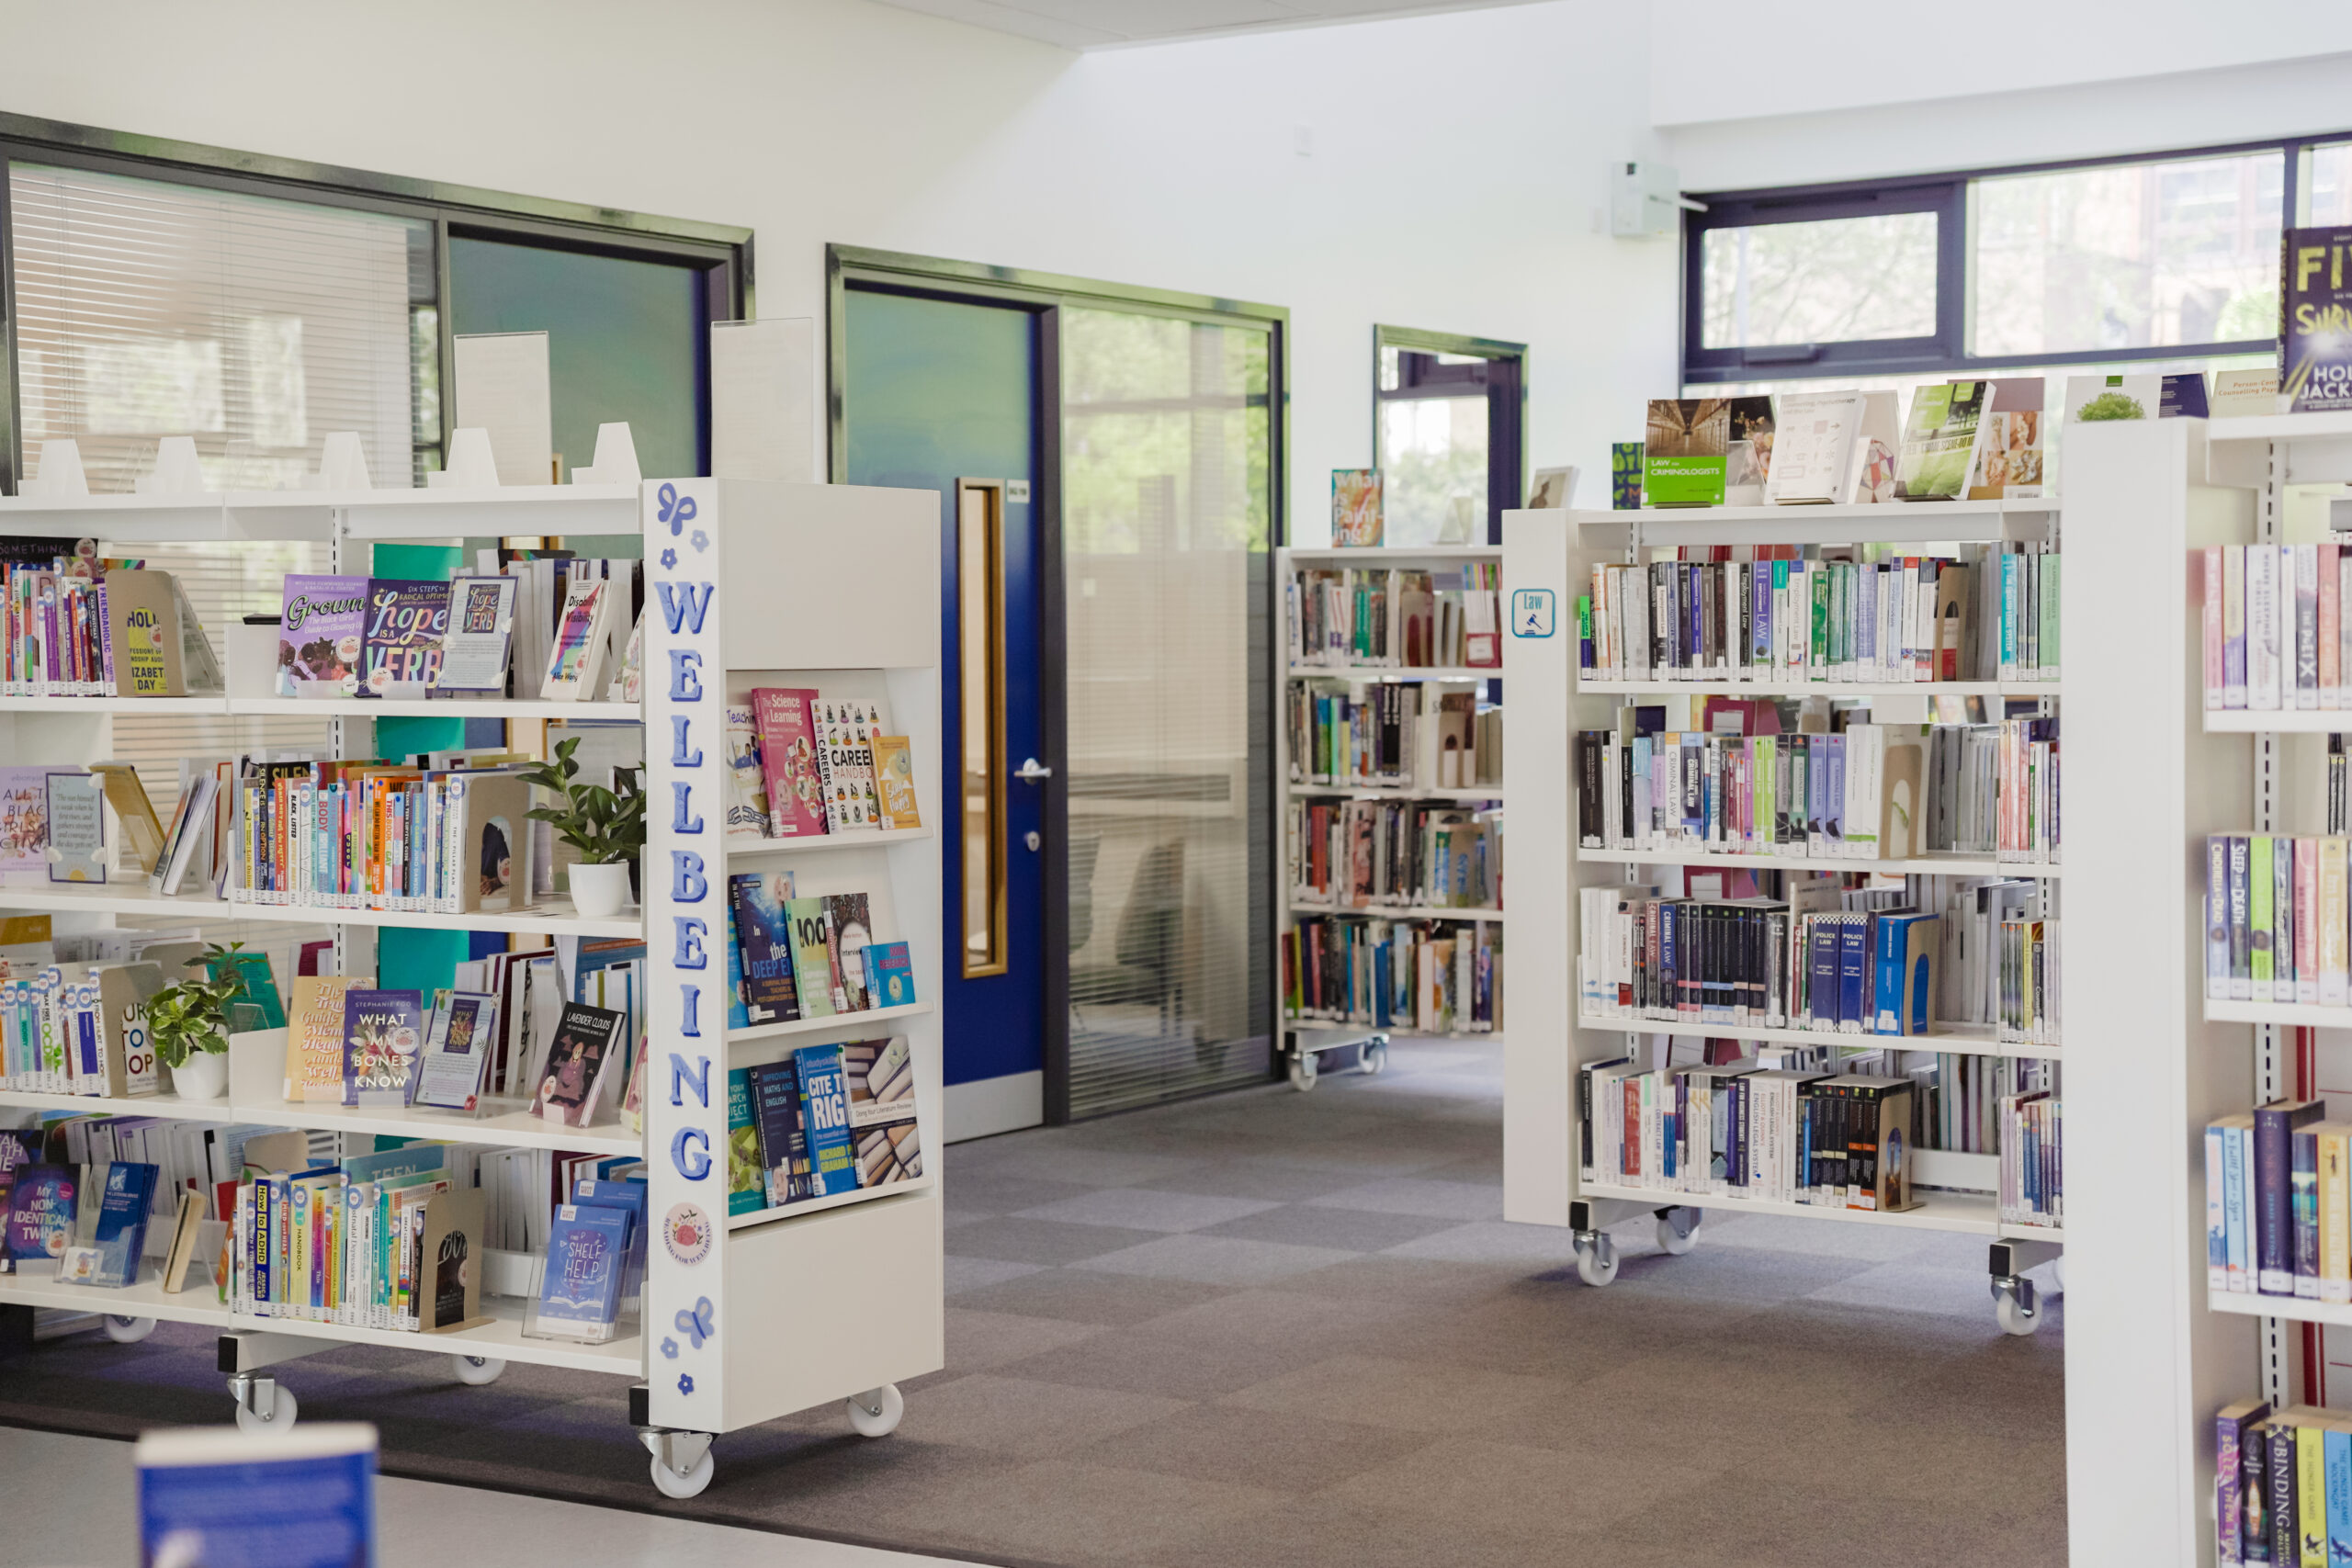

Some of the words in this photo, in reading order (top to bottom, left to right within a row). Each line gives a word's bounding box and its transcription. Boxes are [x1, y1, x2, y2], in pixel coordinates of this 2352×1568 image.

[1333, 471, 1381, 489] What
[1334, 507, 1384, 524] Paint-
[1334, 525, 1373, 545] ing?
[468, 587, 498, 609] hope
[569, 595, 598, 607] Disability
[1523, 593, 1543, 610] Law
[99, 587, 111, 653] FRIENDAHOLIC
[288, 594, 366, 631] Grown
[309, 616, 321, 626] The
[322, 615, 337, 624] Black
[368, 591, 447, 646] hope
[2302, 611, 2312, 626] THE
[304, 625, 322, 634] Guide
[466, 612, 494, 631] VERB
[1757, 614, 1767, 639] LAW
[367, 646, 443, 688] VERB
[2299, 661, 2316, 678] X
[138, 680, 155, 690] DAY
[772, 694, 800, 708] Science
[770, 710, 803, 725] Learning
[818, 739, 831, 786] CAREERS
[258, 768, 266, 799] SILENCE
[4, 789, 30, 800] ALL
[319, 801, 327, 832] BODY
[258, 832, 266, 861] OPTION
[319, 833, 327, 874] BRILLIANT
[2231, 844, 2246, 874] SLEEP
[2211, 844, 2223, 892] CINDERELLA
[653, 581, 716, 1181] WELLBEING
[2212, 898, 2224, 923] DEAD
[2233, 888, 2245, 924] DEATH
[1815, 931, 1836, 940] POLICE
[770, 944, 787, 961] the
[752, 960, 779, 979] DEEP
[359, 1014, 407, 1025] WHAT
[566, 1012, 592, 1027] LAVENDER
[592, 1019, 612, 1030] CLOUDS
[41, 1023, 51, 1055] OCD
[370, 1035, 390, 1045] MY
[354, 1055, 408, 1066] BONES
[355, 1077, 407, 1088] KNOW
[763, 1070, 792, 1083] IMPROVING
[729, 1083, 745, 1093] YOUR
[763, 1083, 781, 1095] MATHS
[782, 1082, 794, 1091] AND
[808, 1076, 832, 1096] CITE
[765, 1096, 787, 1108] ENGLISH
[855, 1110, 866, 1119] Doing
[867, 1109, 876, 1117] Your
[876, 1106, 896, 1115] Literature
[897, 1102, 912, 1112] Review
[819, 1147, 846, 1161] RICHARD
[372, 1165, 416, 1178] TEEN
[820, 1159, 849, 1172] GRAHAM
[37, 1186, 51, 1196] MY
[30, 1199, 56, 1211] NON-
[14, 1213, 66, 1226] IDENTICAL
[22, 1227, 53, 1240] TWIN
[568, 1242, 603, 1259] SHELF
[564, 1258, 599, 1280] HELP
[2274, 1445, 2291, 1528] BINDING
[2223, 1485, 2235, 1524] THEM
